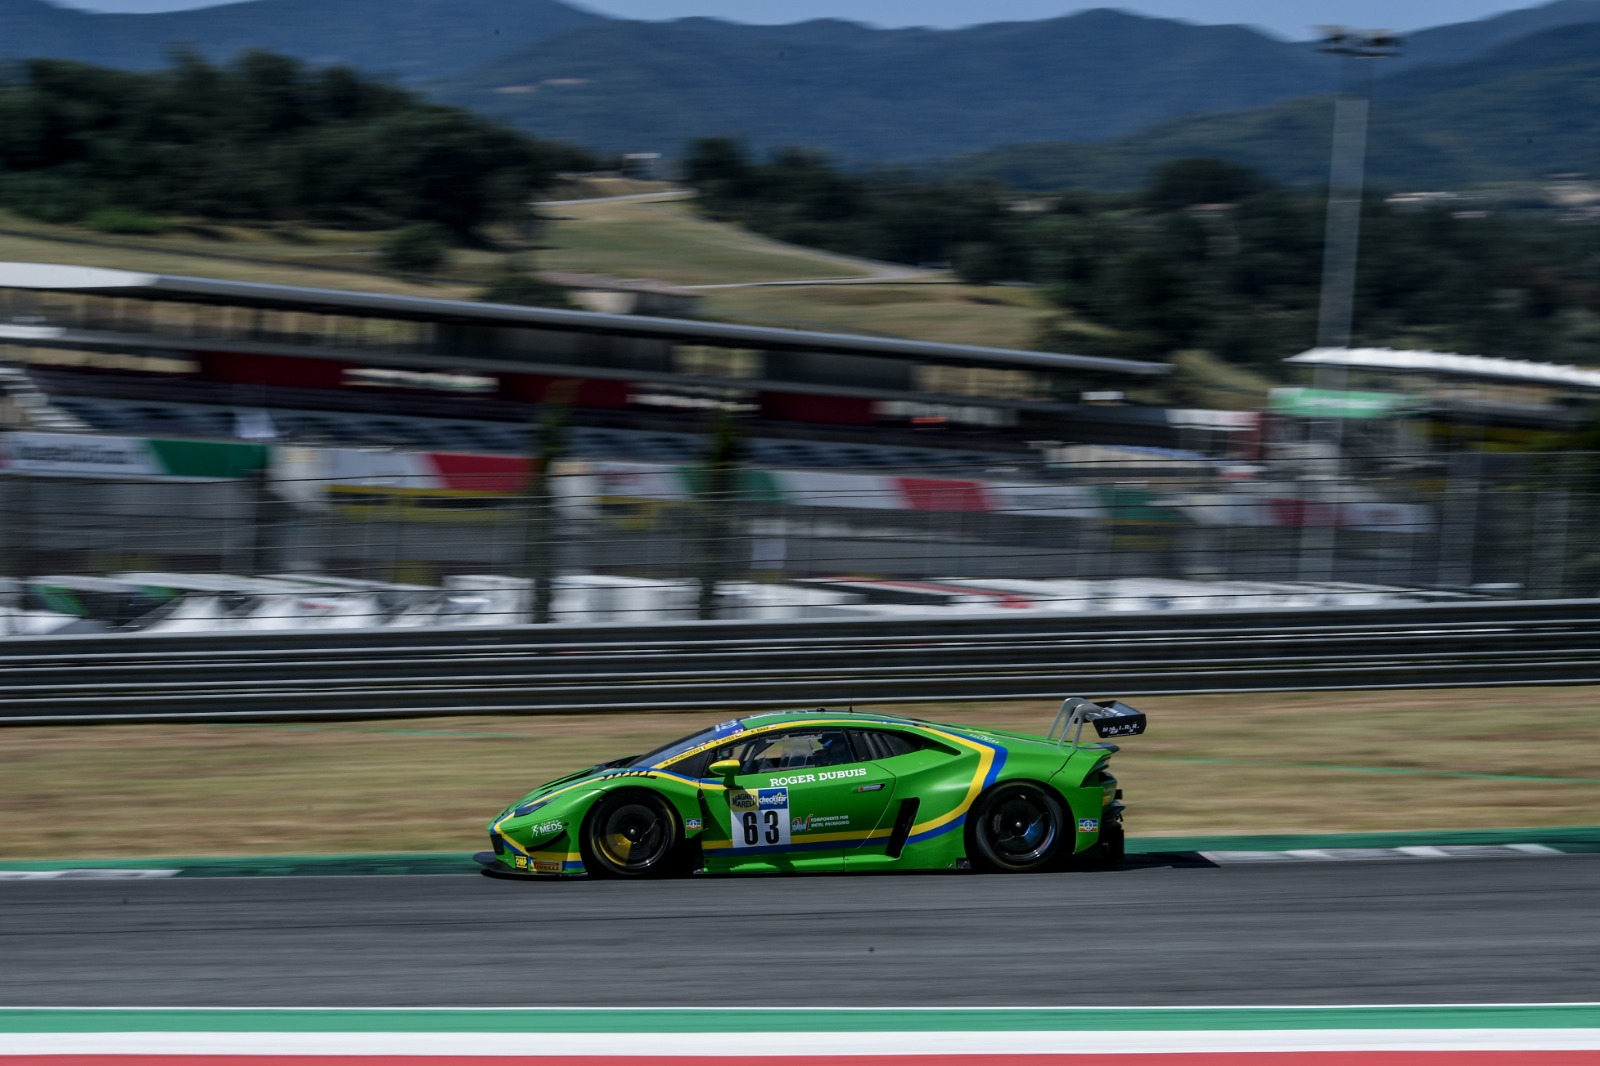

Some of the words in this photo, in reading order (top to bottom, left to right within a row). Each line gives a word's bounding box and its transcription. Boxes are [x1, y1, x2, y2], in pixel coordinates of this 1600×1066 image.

[769, 774, 815, 787] ROGER
[818, 768, 867, 781] DUBUIS
[539, 822, 563, 834] MEDS
[742, 810, 779, 845] 63
[515, 857, 527, 866] OMP
